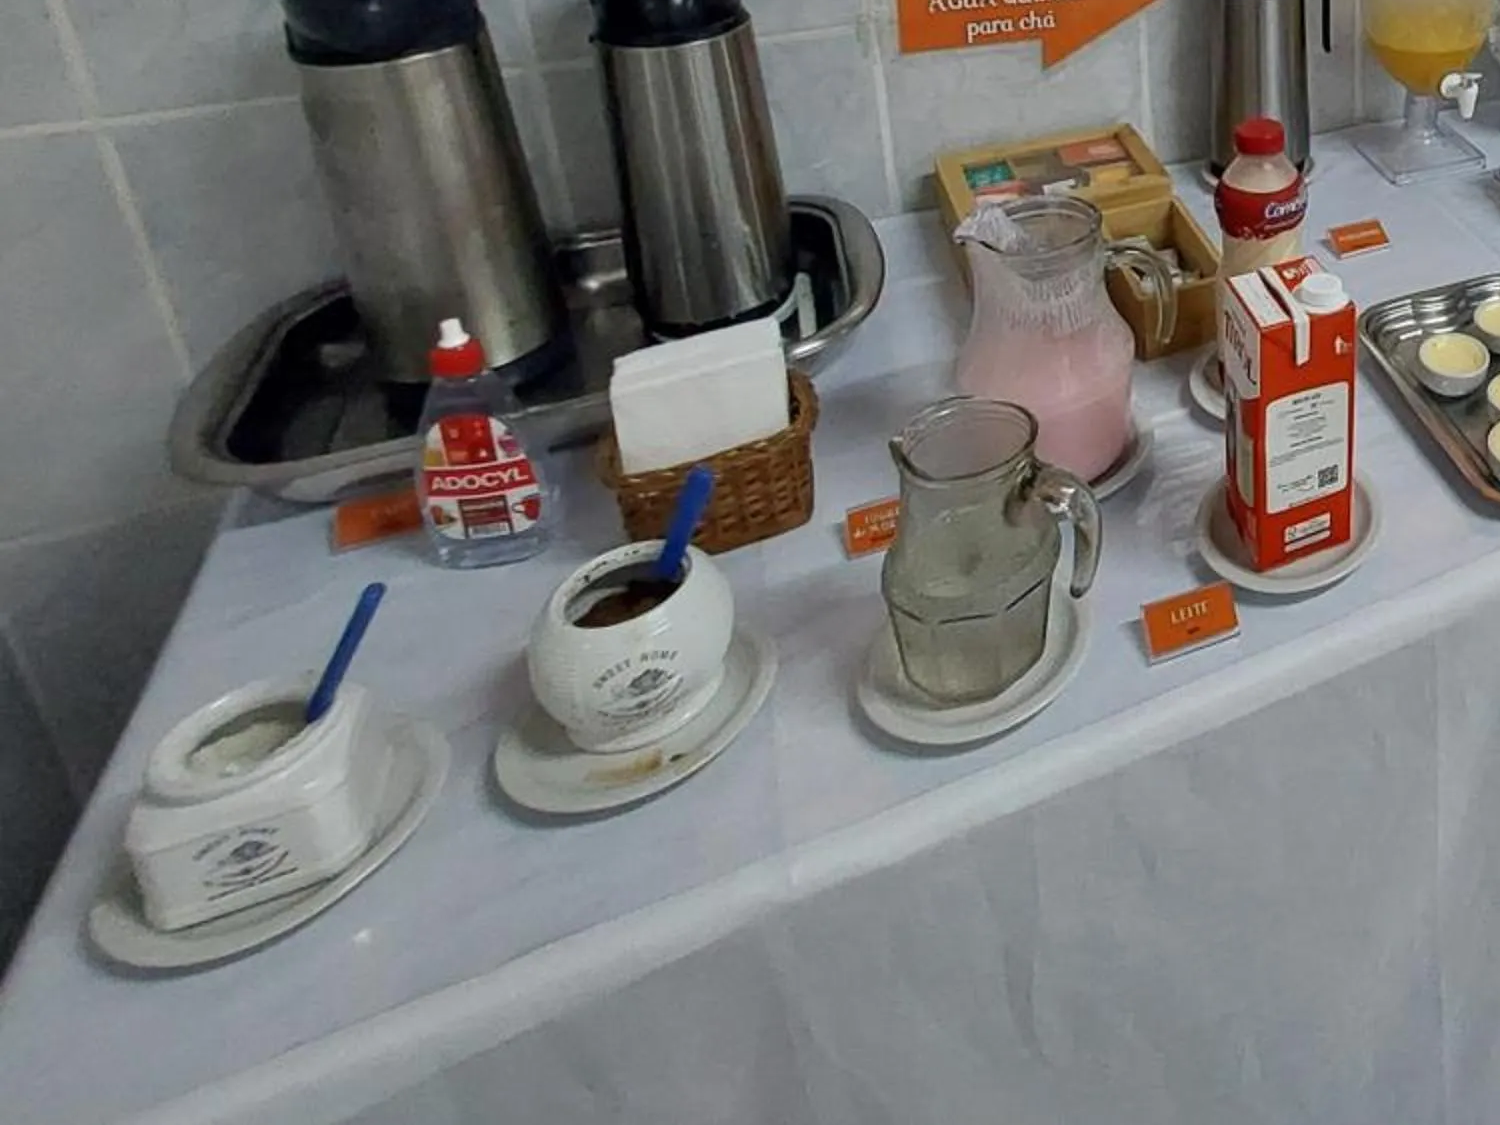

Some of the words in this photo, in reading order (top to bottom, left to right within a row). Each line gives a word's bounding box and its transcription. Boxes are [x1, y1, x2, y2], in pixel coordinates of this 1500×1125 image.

[967, 19, 1013, 42] para
[1019, 11, 1056, 29] chá
[432, 466, 529, 491] ADOCYL
[1170, 599, 1210, 626] LEITE
